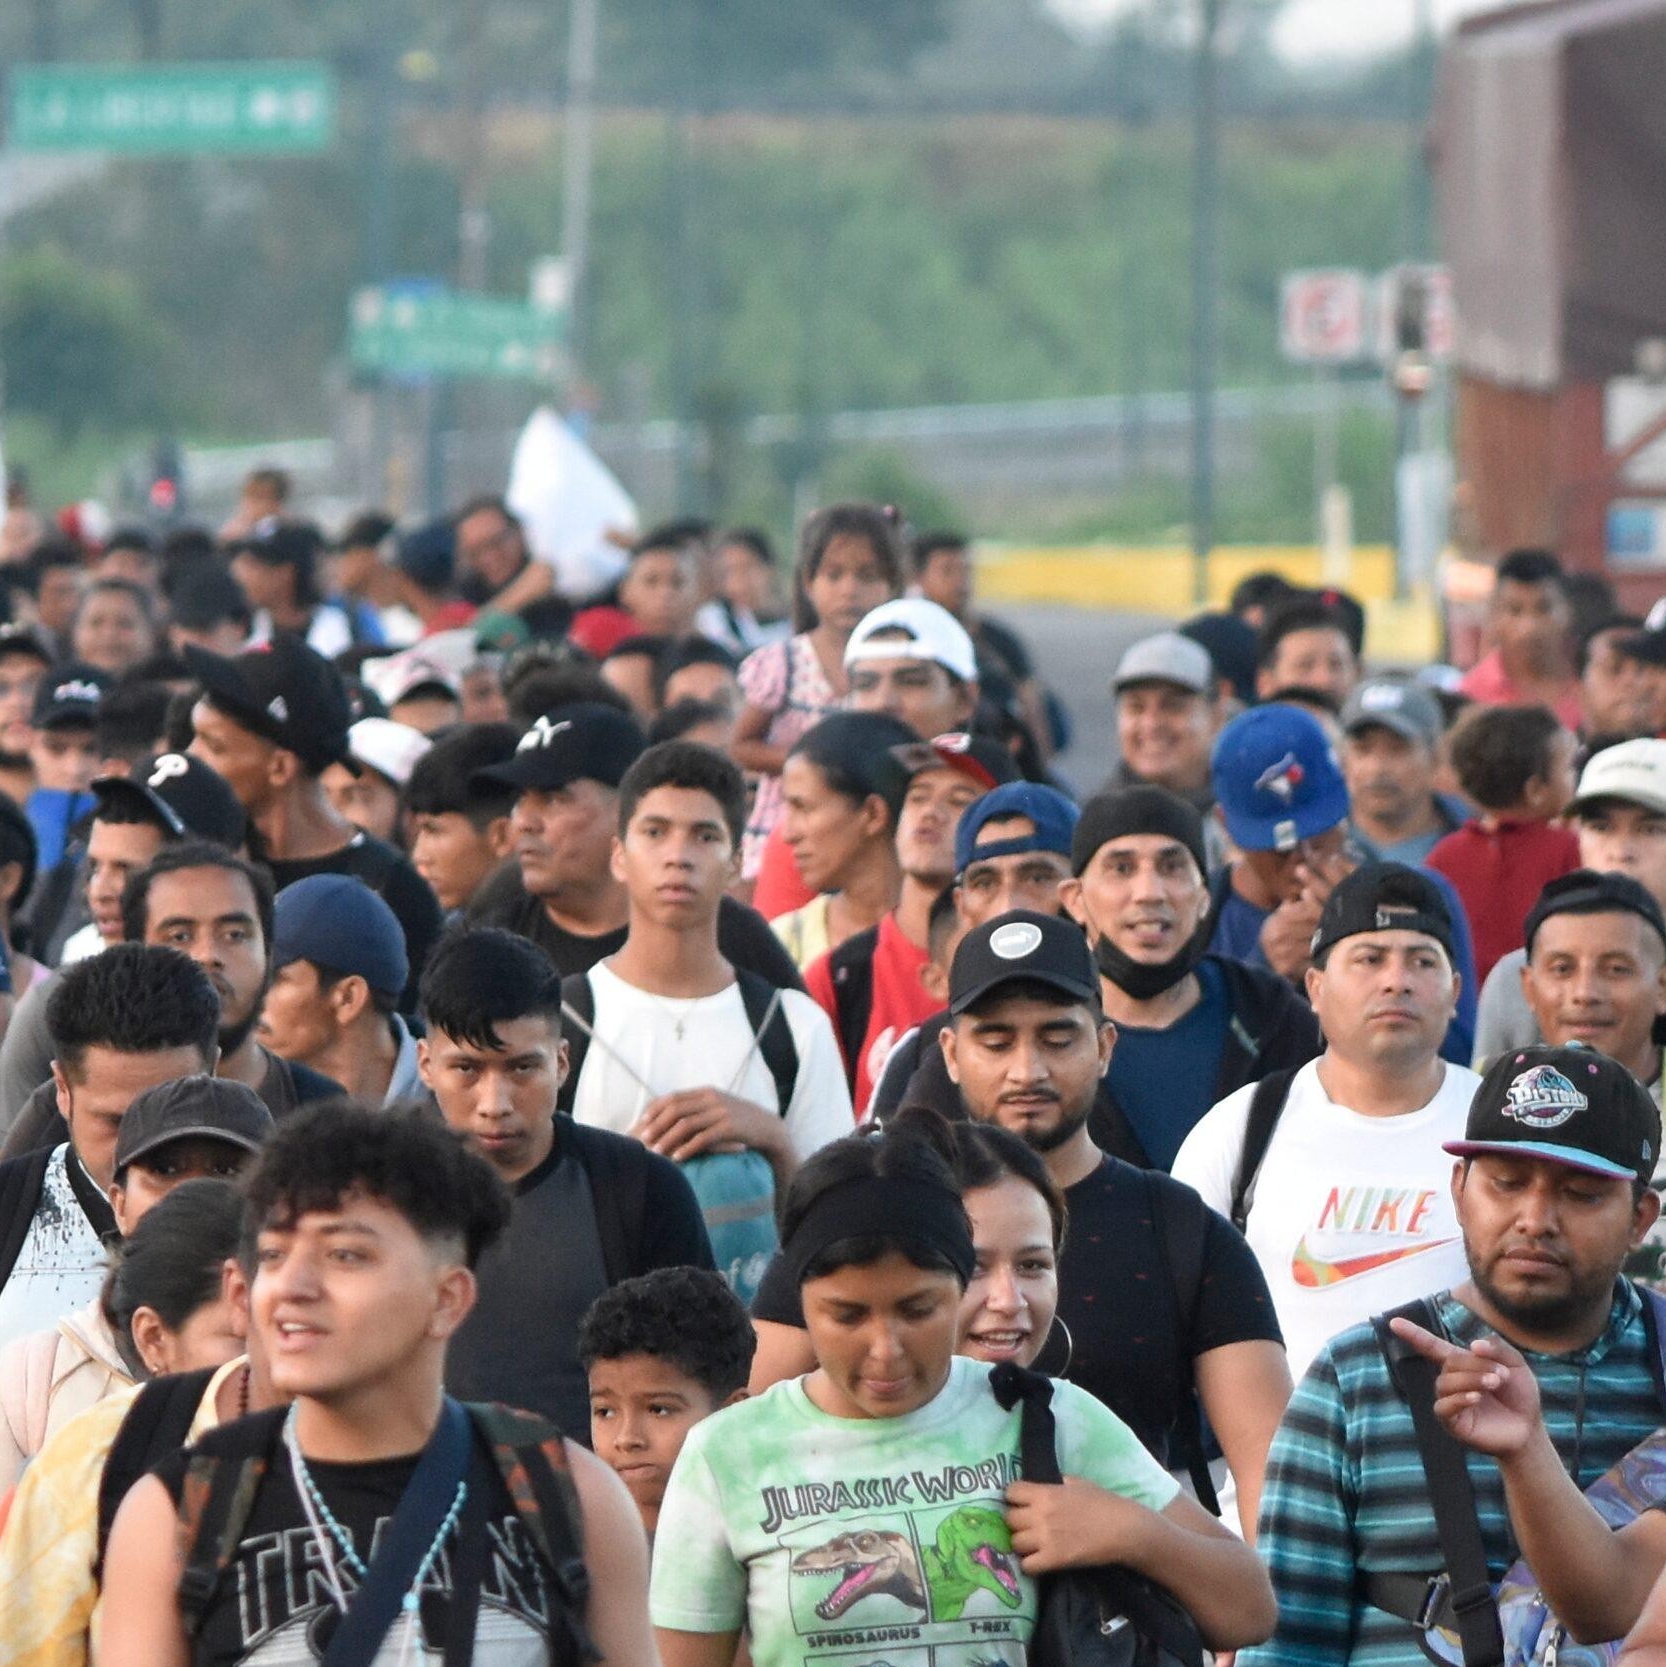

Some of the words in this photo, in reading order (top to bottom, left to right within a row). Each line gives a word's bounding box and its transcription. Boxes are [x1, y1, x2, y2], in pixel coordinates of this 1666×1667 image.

[1316, 1186, 1437, 1233] NIKE
[759, 1475, 915, 1534] JURASSIC
[807, 1626, 921, 1648] SPINOSAURUS
[968, 1620, 1011, 1634] T-REX
